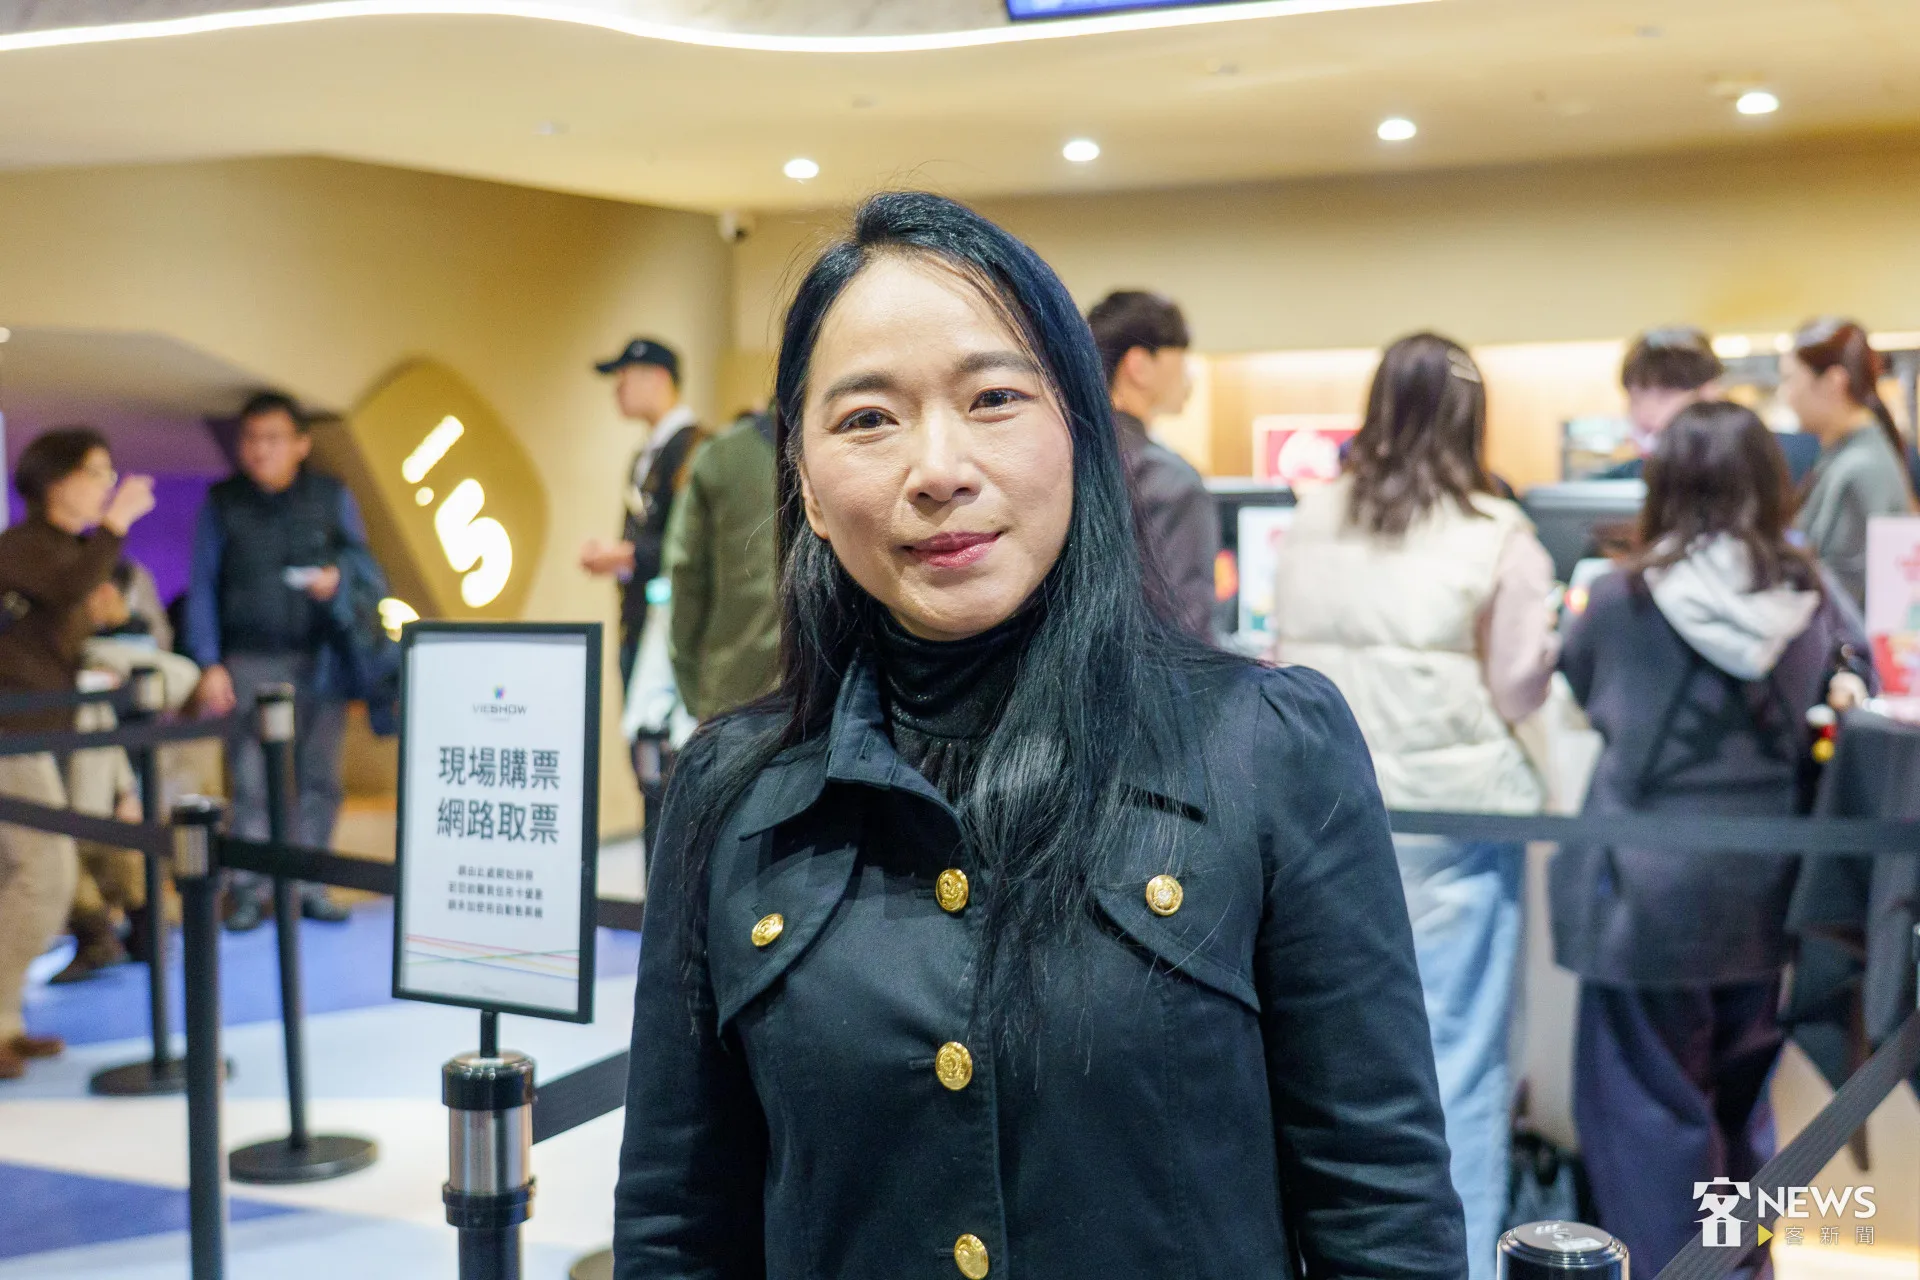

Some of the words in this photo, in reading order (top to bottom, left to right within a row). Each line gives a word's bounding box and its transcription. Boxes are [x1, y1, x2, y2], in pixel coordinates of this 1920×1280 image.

[438, 746, 560, 789] 現場購票
[437, 797, 560, 844] 網路取票
